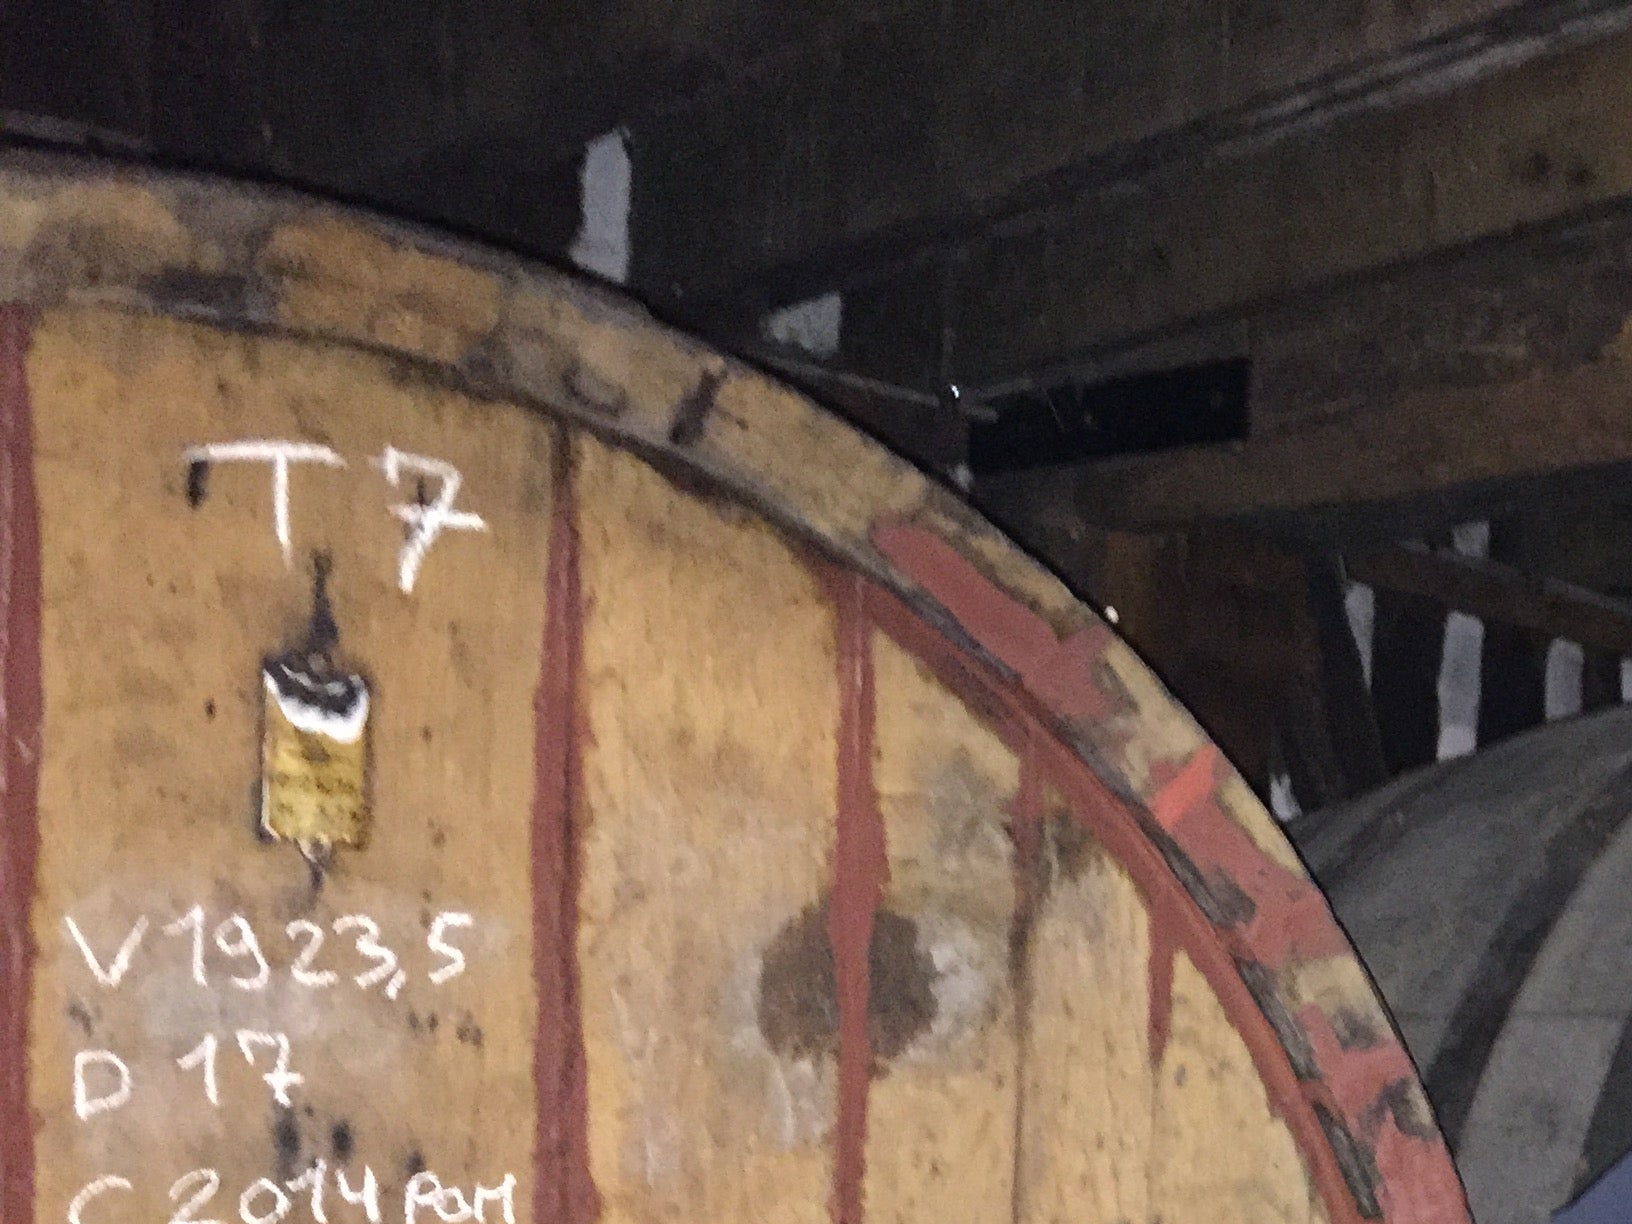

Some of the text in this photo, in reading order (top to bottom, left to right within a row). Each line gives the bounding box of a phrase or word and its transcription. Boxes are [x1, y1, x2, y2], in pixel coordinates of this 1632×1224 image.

[184, 439, 488, 593] T 7
[65, 915, 149, 988] V
[74, 1029, 303, 1121] D 17
